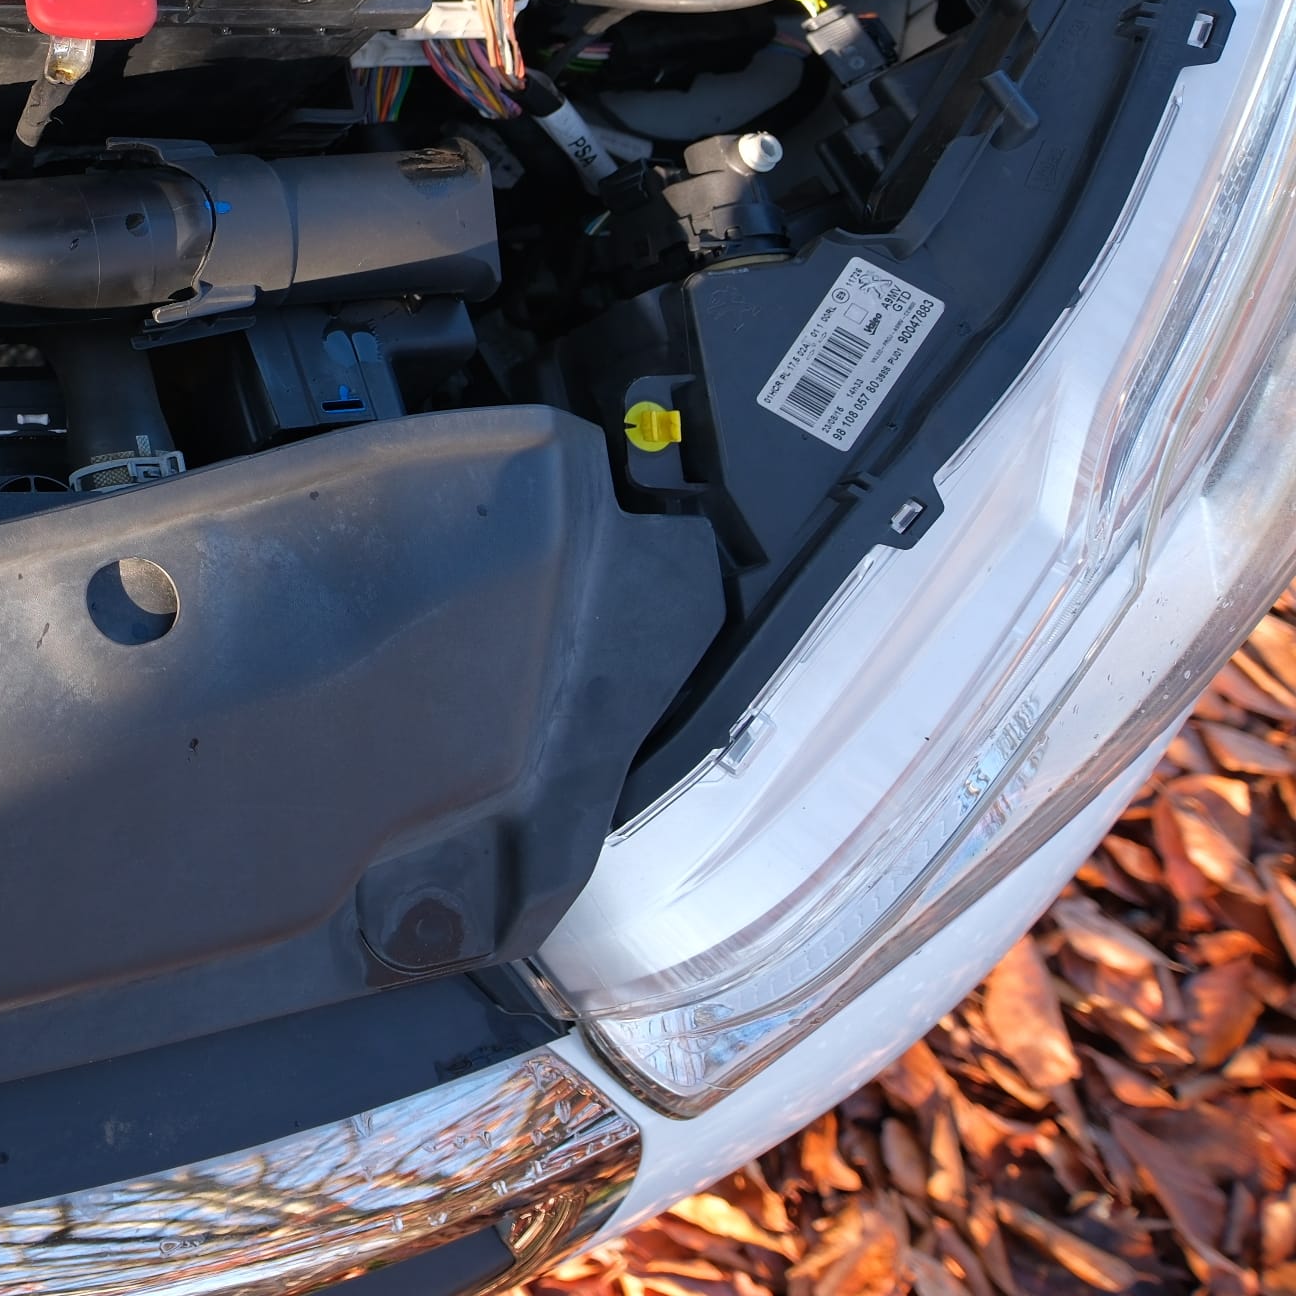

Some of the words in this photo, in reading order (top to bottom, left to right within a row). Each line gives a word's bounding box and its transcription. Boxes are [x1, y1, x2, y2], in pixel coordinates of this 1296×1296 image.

[567, 135, 598, 168] PSA
[880, 285, 901, 309] A9MV
[892, 290, 911, 312] GTD
[863, 312, 882, 333] Valeo
[832, 427, 846, 441] 98
[841, 410, 858, 428] 108
[853, 393, 870, 411] 057
[865, 380, 879, 393] 80
[897, 298, 934, 344] 90047883
